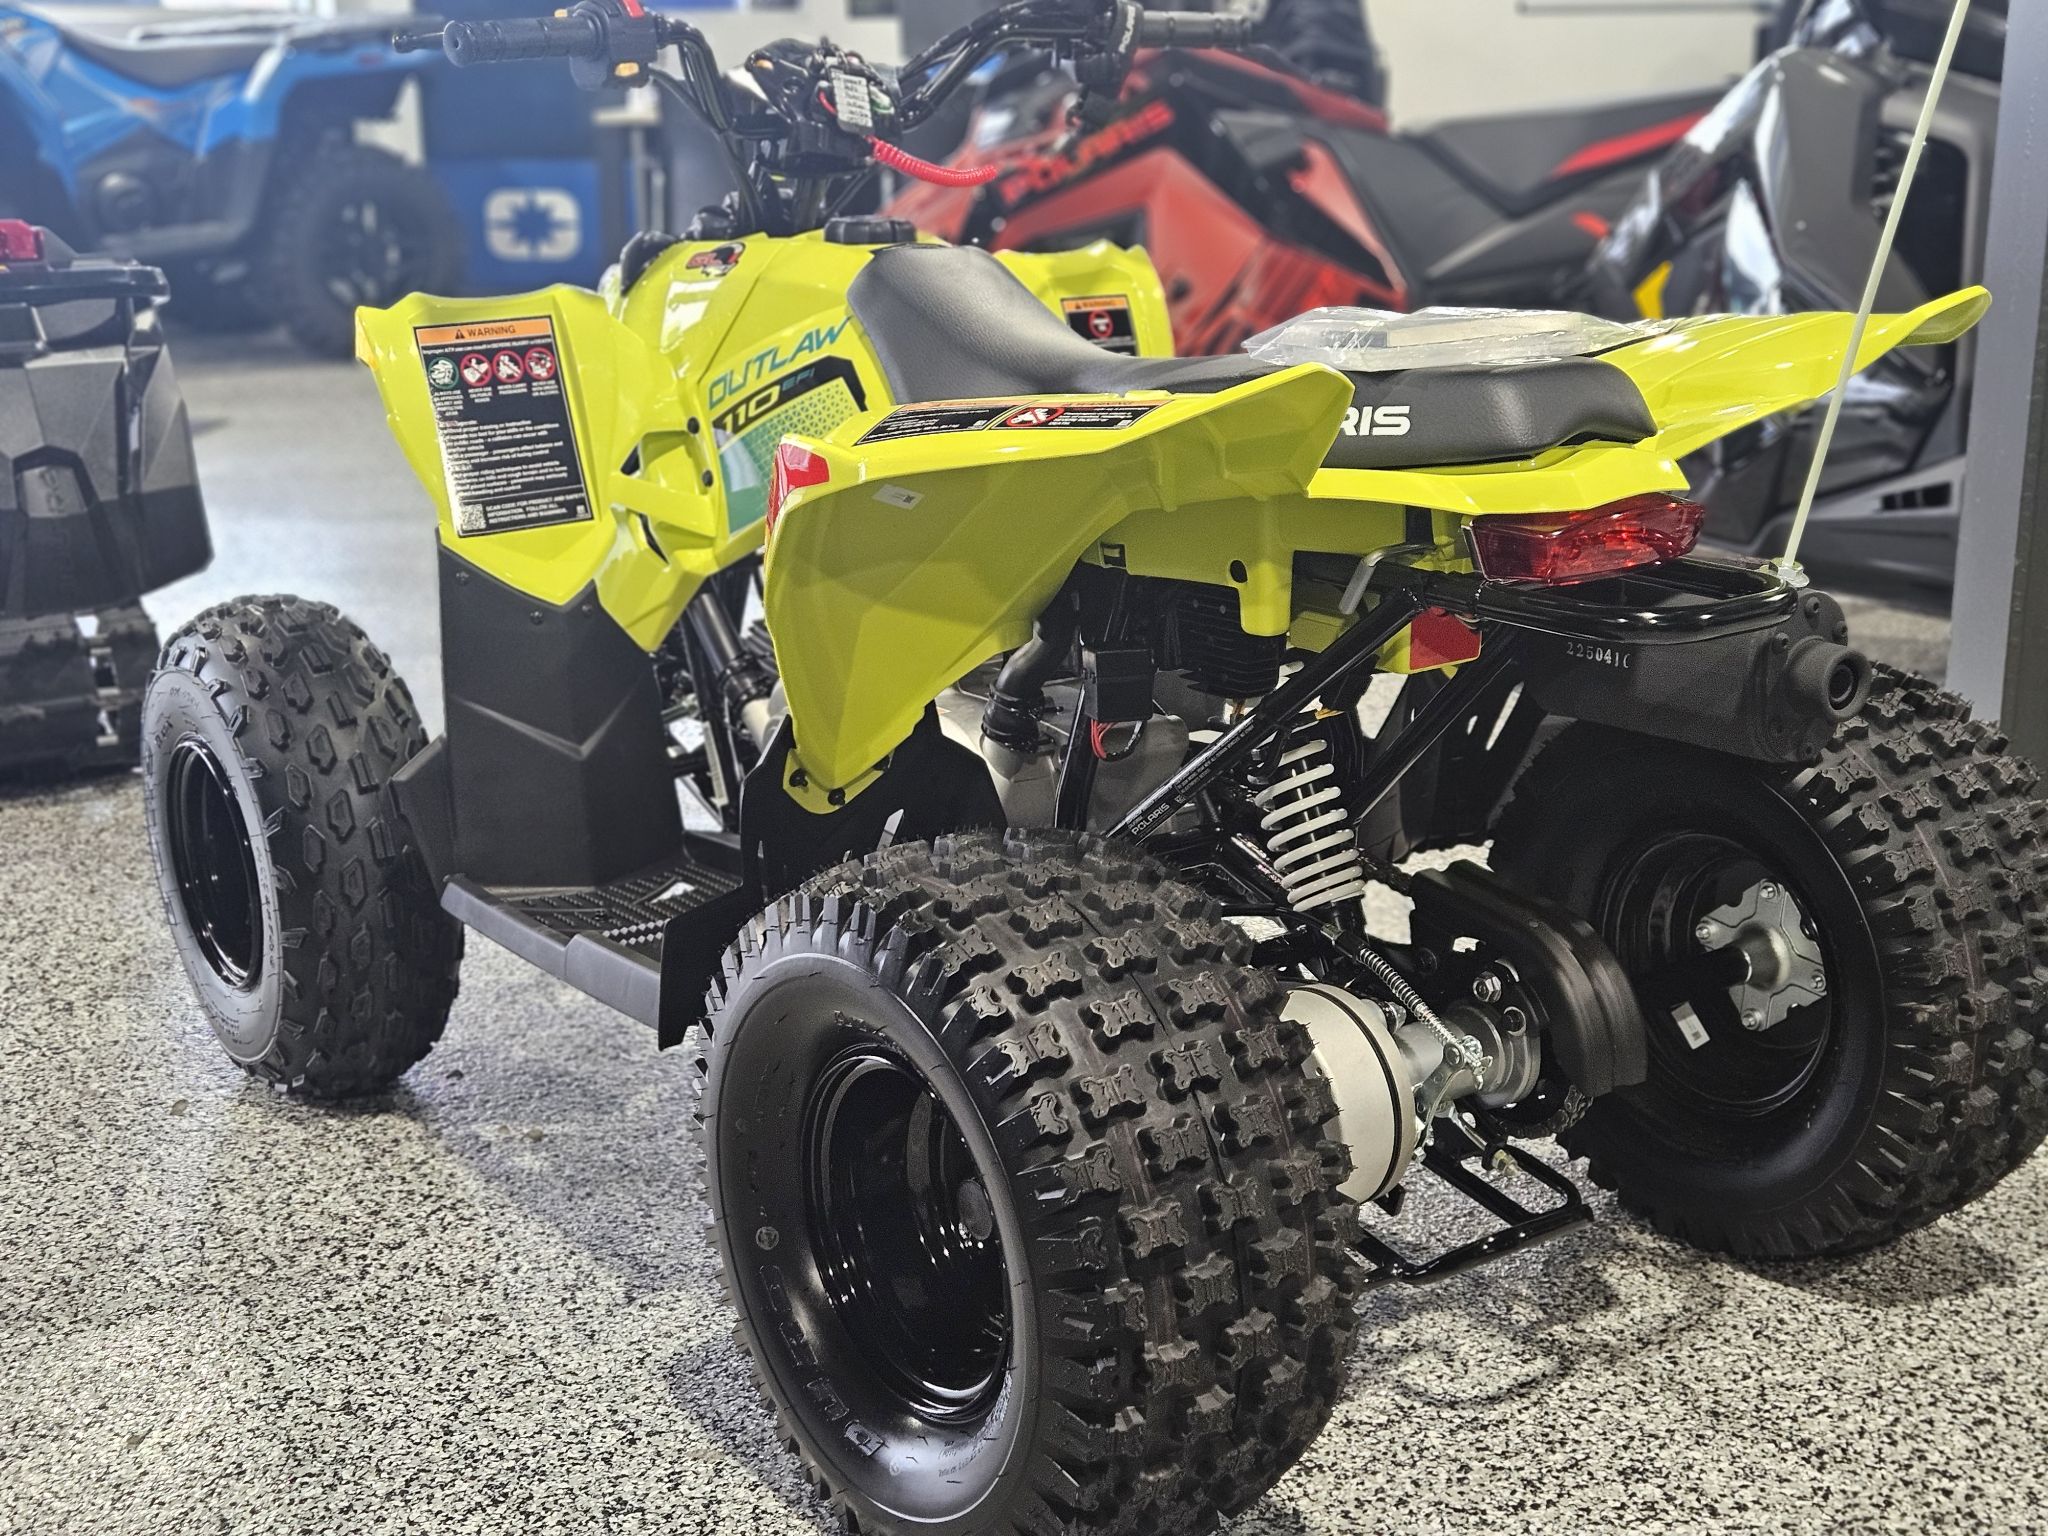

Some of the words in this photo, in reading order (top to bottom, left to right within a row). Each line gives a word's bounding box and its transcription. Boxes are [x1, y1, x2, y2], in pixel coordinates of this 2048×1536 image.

[467, 325, 516, 338] WARNING
[709, 316, 853, 411] OUTLAW
[782, 367, 815, 391] EFI
[722, 384, 781, 433] 110
[1131, 803, 1170, 835] POLARIS
